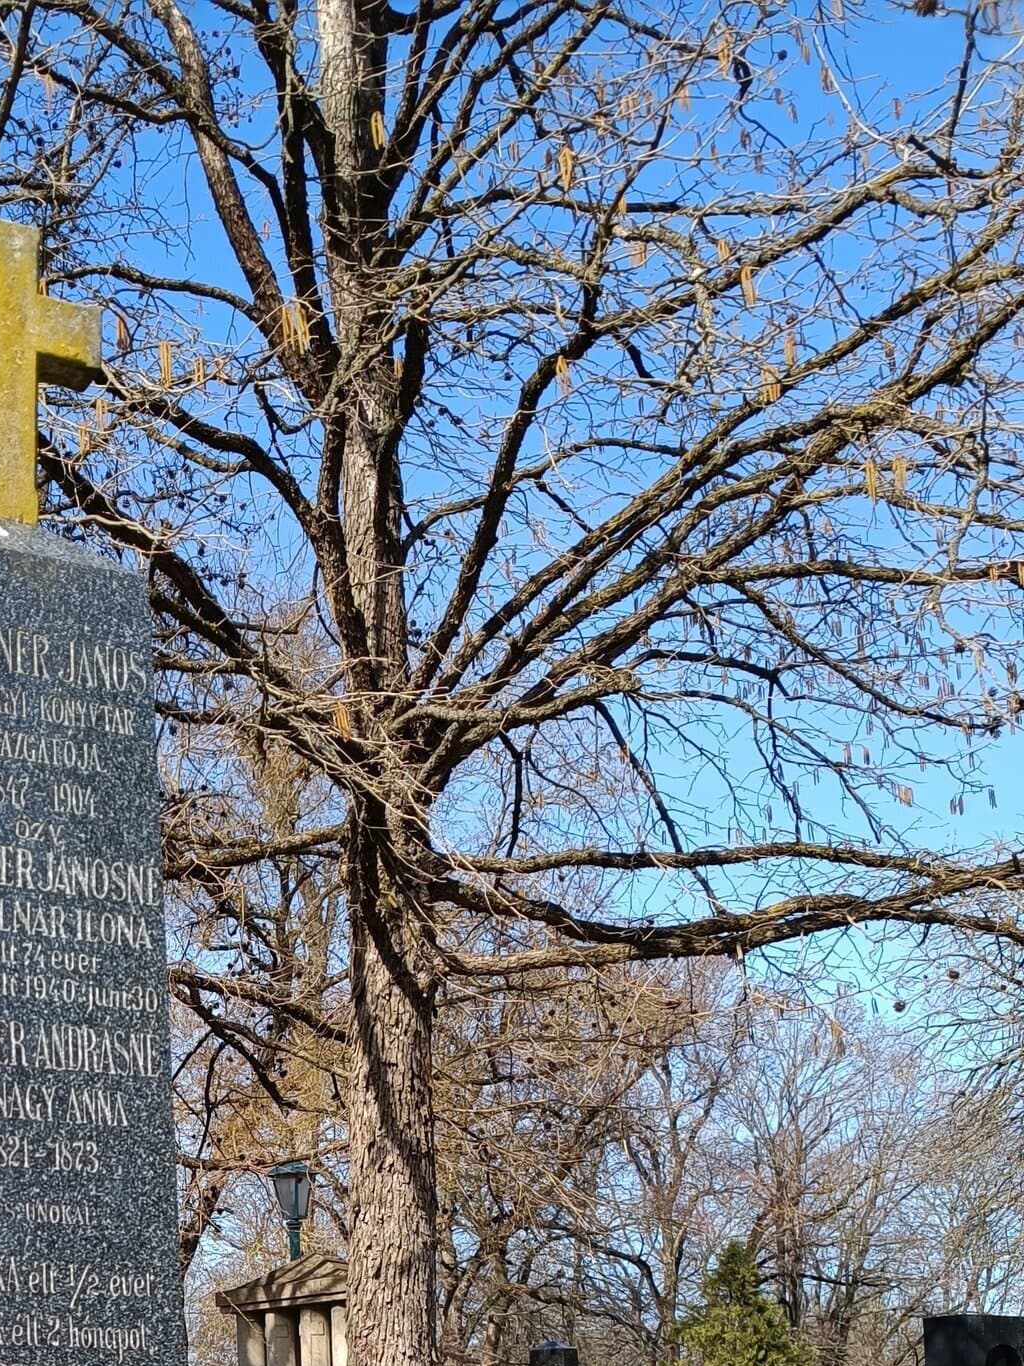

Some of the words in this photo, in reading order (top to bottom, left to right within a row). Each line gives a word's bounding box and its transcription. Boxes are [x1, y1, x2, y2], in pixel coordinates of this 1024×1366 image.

[38, 850, 161, 907] JÁNOSNÉ
[76, 908, 154, 950] ILONA
[22, 941, 45, 968] 74
[25, 974, 76, 1003] 1940
[35, 1016, 161, 1078] ANDRÁSNÉ
[67, 1087, 128, 1127] ANNA
[53, 1141, 99, 1174] 1873
[47, 1315, 60, 1347] 2
